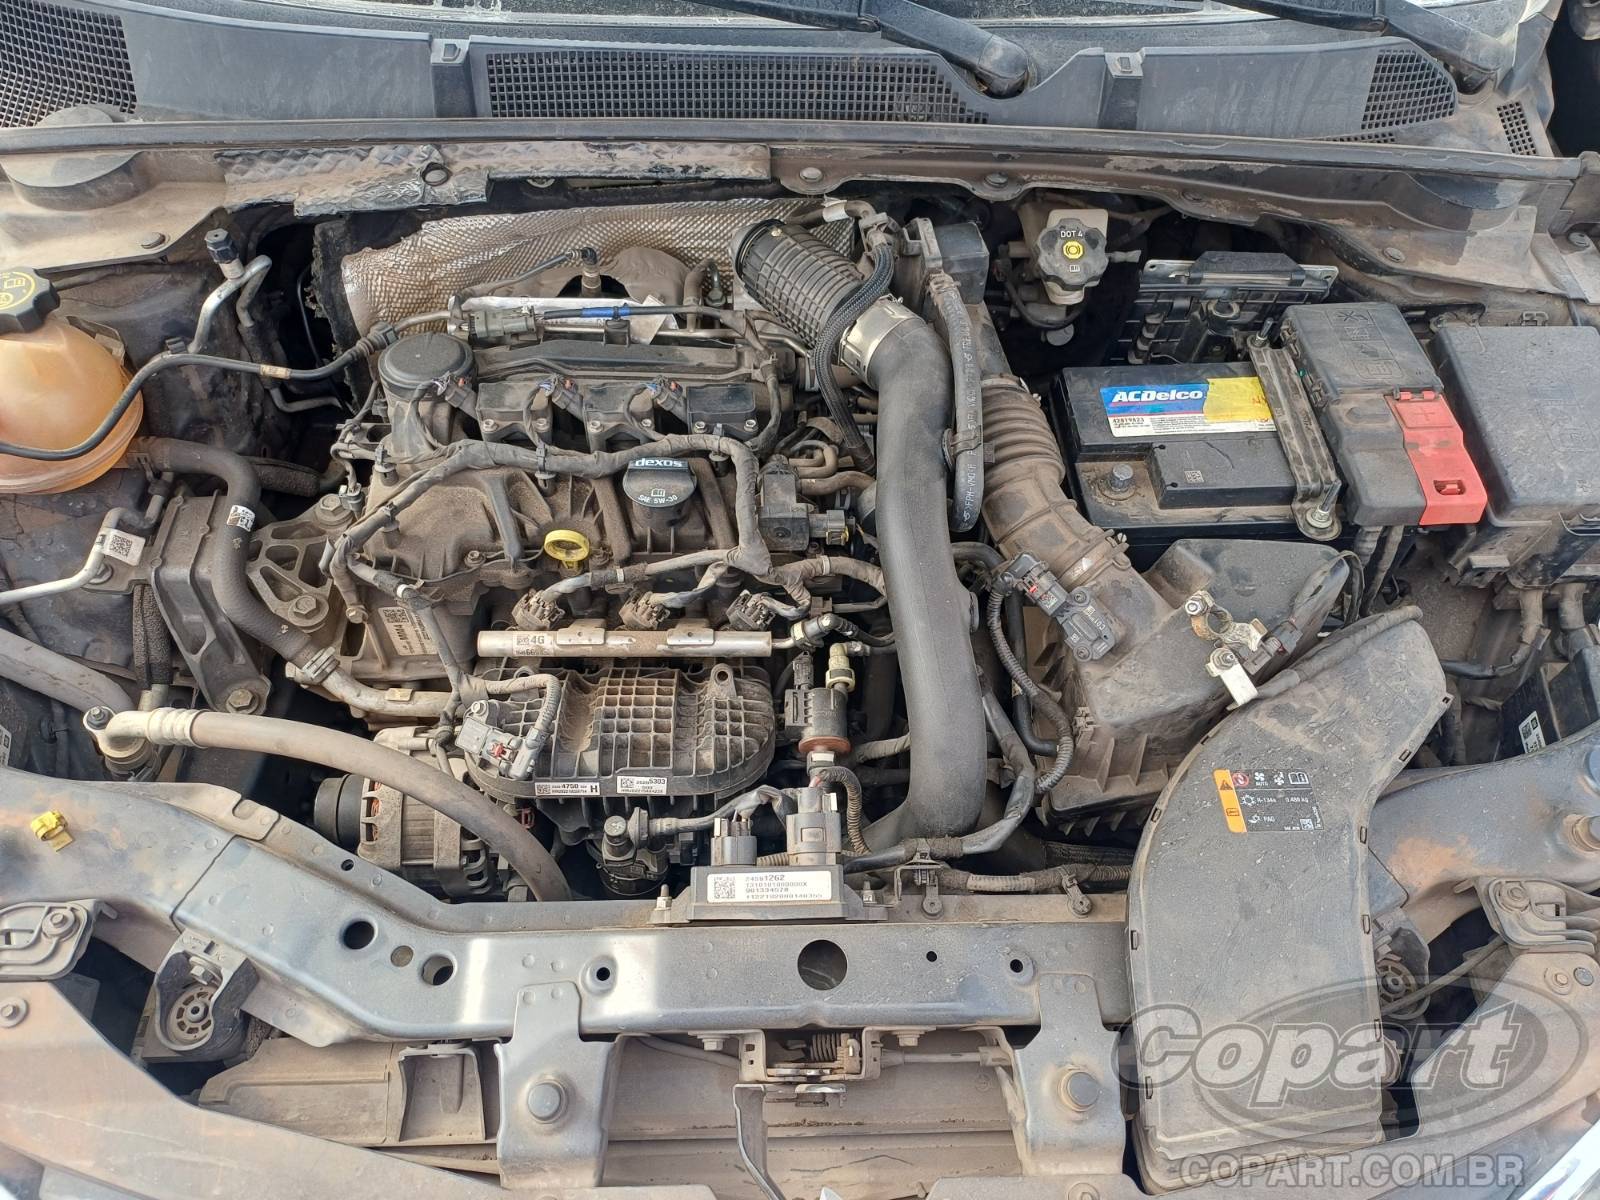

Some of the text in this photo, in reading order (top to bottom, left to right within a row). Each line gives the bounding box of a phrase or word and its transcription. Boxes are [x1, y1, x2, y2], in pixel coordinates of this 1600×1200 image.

[1060, 230, 1076, 238] DOT
[1111, 389, 1203, 403] ACDelco
[635, 458, 683, 467] dexos
[638, 494, 678, 504] SAE 5W-30
[530, 635, 545, 645] 4G
[590, 785, 598, 793] H
